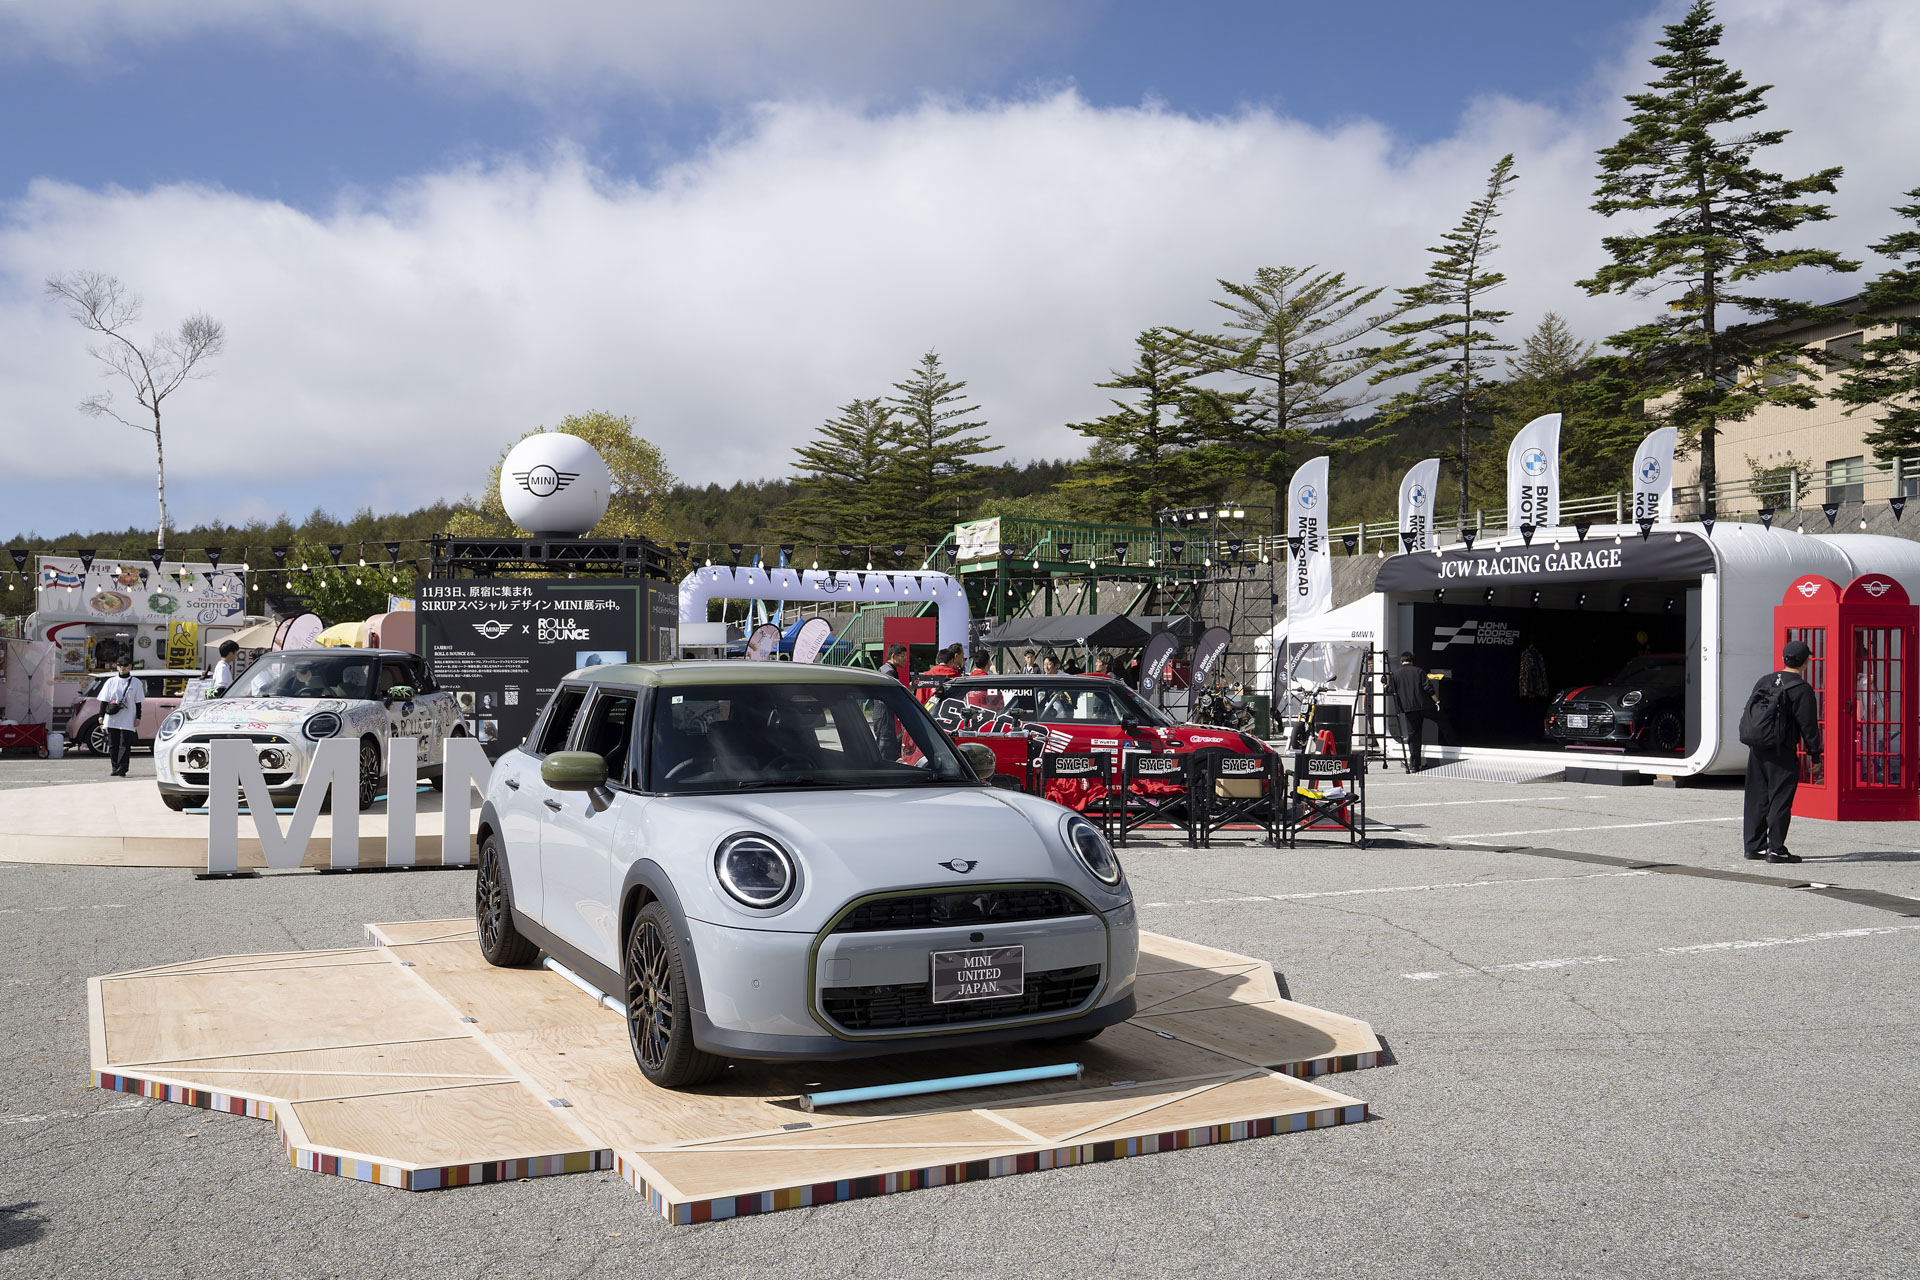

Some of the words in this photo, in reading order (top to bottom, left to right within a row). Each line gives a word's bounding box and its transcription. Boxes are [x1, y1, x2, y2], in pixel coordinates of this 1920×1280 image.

[530, 476, 555, 486] MINI
[1536, 485, 1548, 528] BMW
[1635, 492, 1645, 524] MO
[1308, 517, 1318, 553] BMW
[1298, 516, 1309, 597] MOTORRAD
[69, 563, 111, 574] タ料理
[1437, 560, 1474, 579] JCW
[1476, 554, 1541, 577] RACING
[1544, 548, 1622, 573] GARAGE
[422, 586, 533, 598] 11月3日、原宿に集まれ
[538, 617, 576, 629] ROLL&
[1478, 621, 1508, 630] JOHN
[538, 629, 590, 640] BOUNCE
[1351, 630, 1369, 638] BMW
[1477, 629, 1521, 638] COOPER
[1476, 637, 1515, 645] WORKS
[1152, 647, 1174, 679] MOTORRAD
[1200, 654, 1210, 670] BMW
[1204, 642, 1225, 673] MOTORRAD
[1148, 659, 1159, 676] BMW
[1056, 757, 1089, 770] SYCG
[1138, 758, 1173, 771] SYCG
[1221, 758, 1256, 771] SYCG
[1246, 766, 1265, 774] Racing
[1308, 759, 1343, 772] SYCG
[1332, 767, 1351, 776] Racing
[208, 737, 494, 875] MIN
[963, 955, 993, 968] MINI
[957, 967, 1002, 983] UNITED
[958, 981, 1000, 995] JAPAN.
